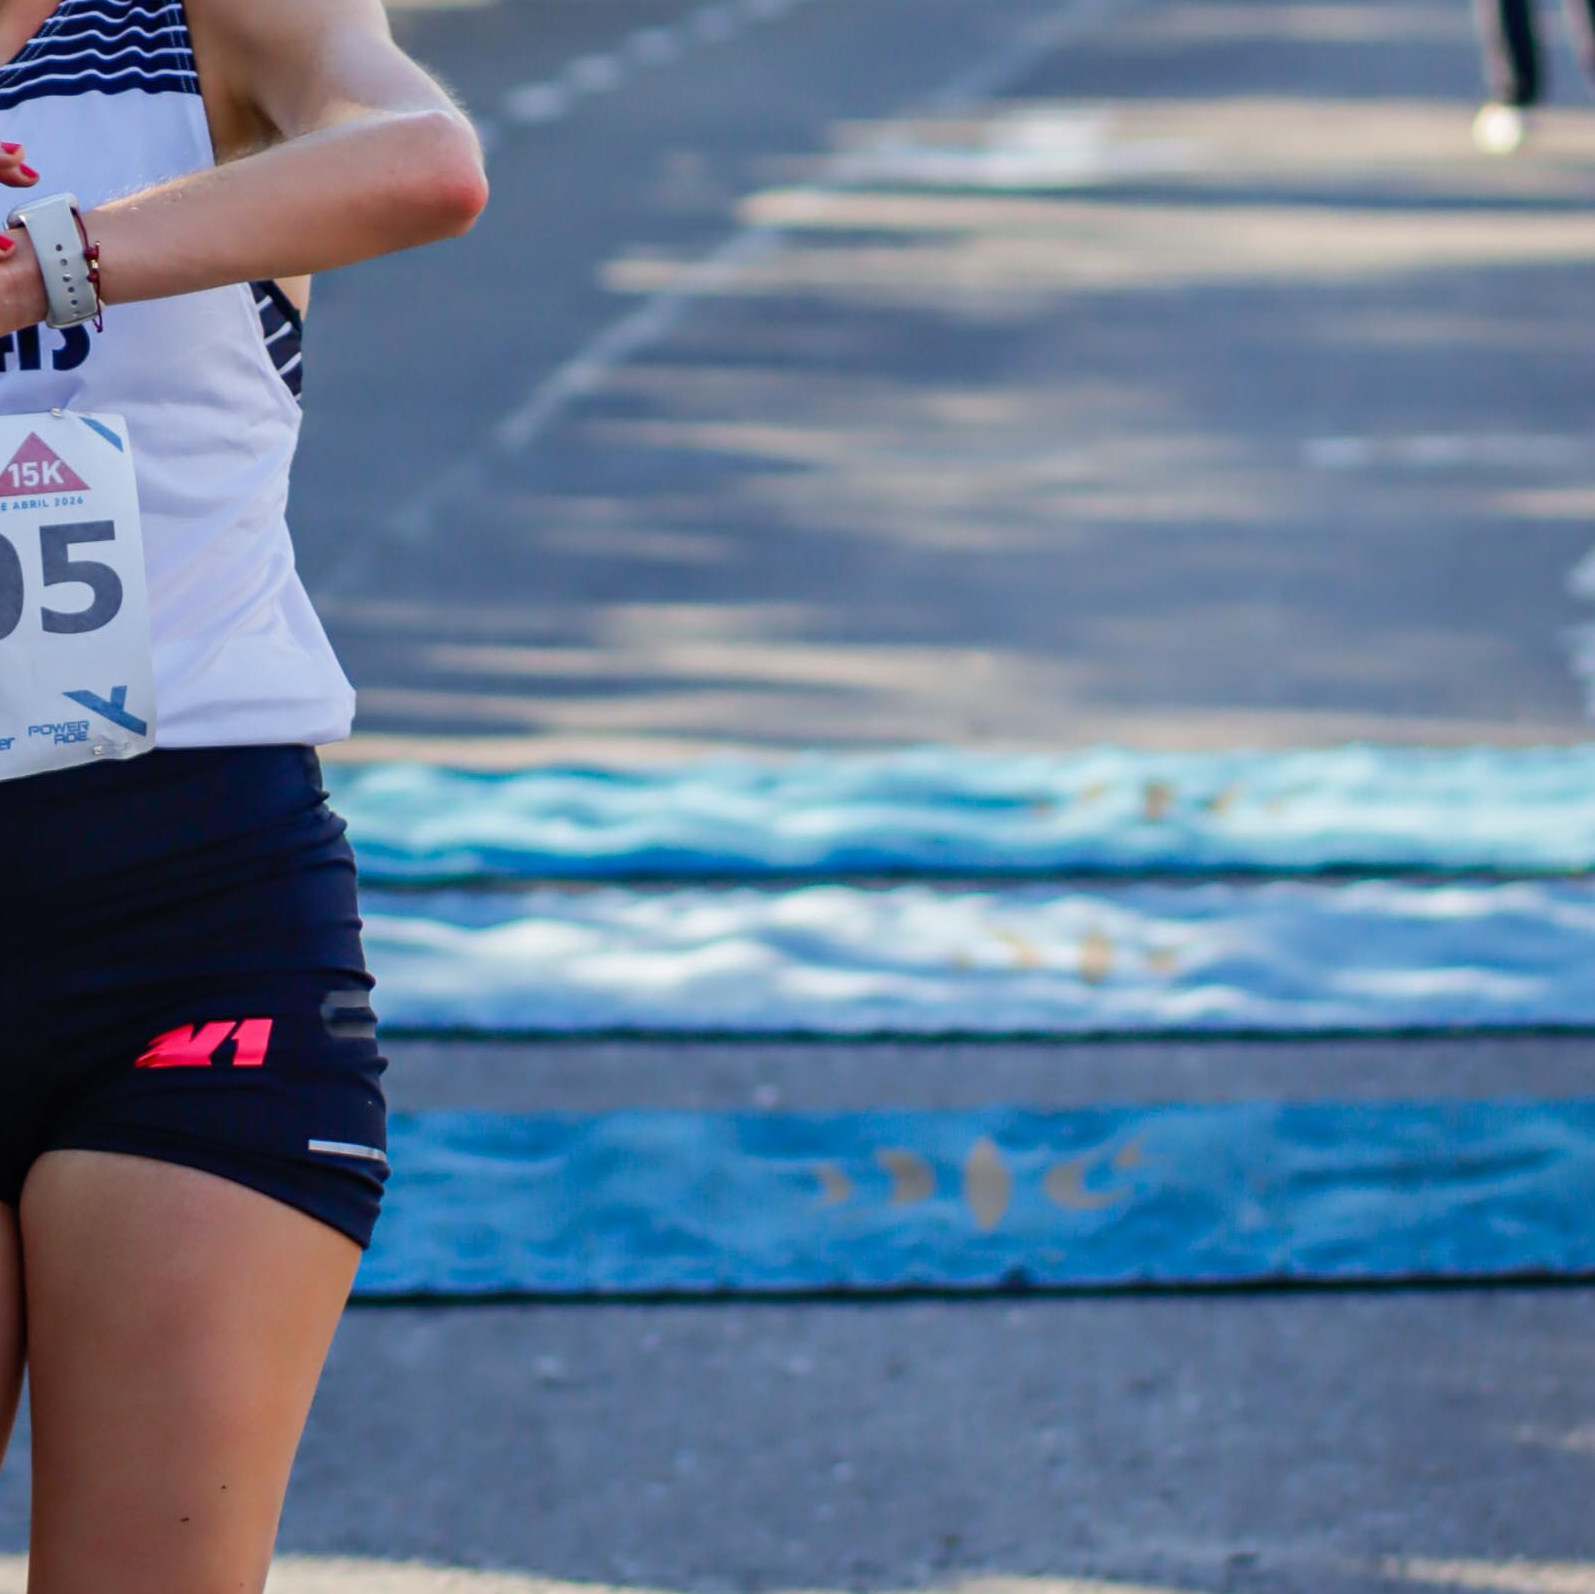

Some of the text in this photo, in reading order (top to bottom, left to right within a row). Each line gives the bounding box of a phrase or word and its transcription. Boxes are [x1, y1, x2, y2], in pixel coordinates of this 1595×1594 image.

[8, 459, 65, 489] 15K
[13, 499, 49, 511] ABRIL
[54, 495, 84, 507] 2026
[27, 720, 90, 737] POWER
[54, 732, 89, 745] ADE
